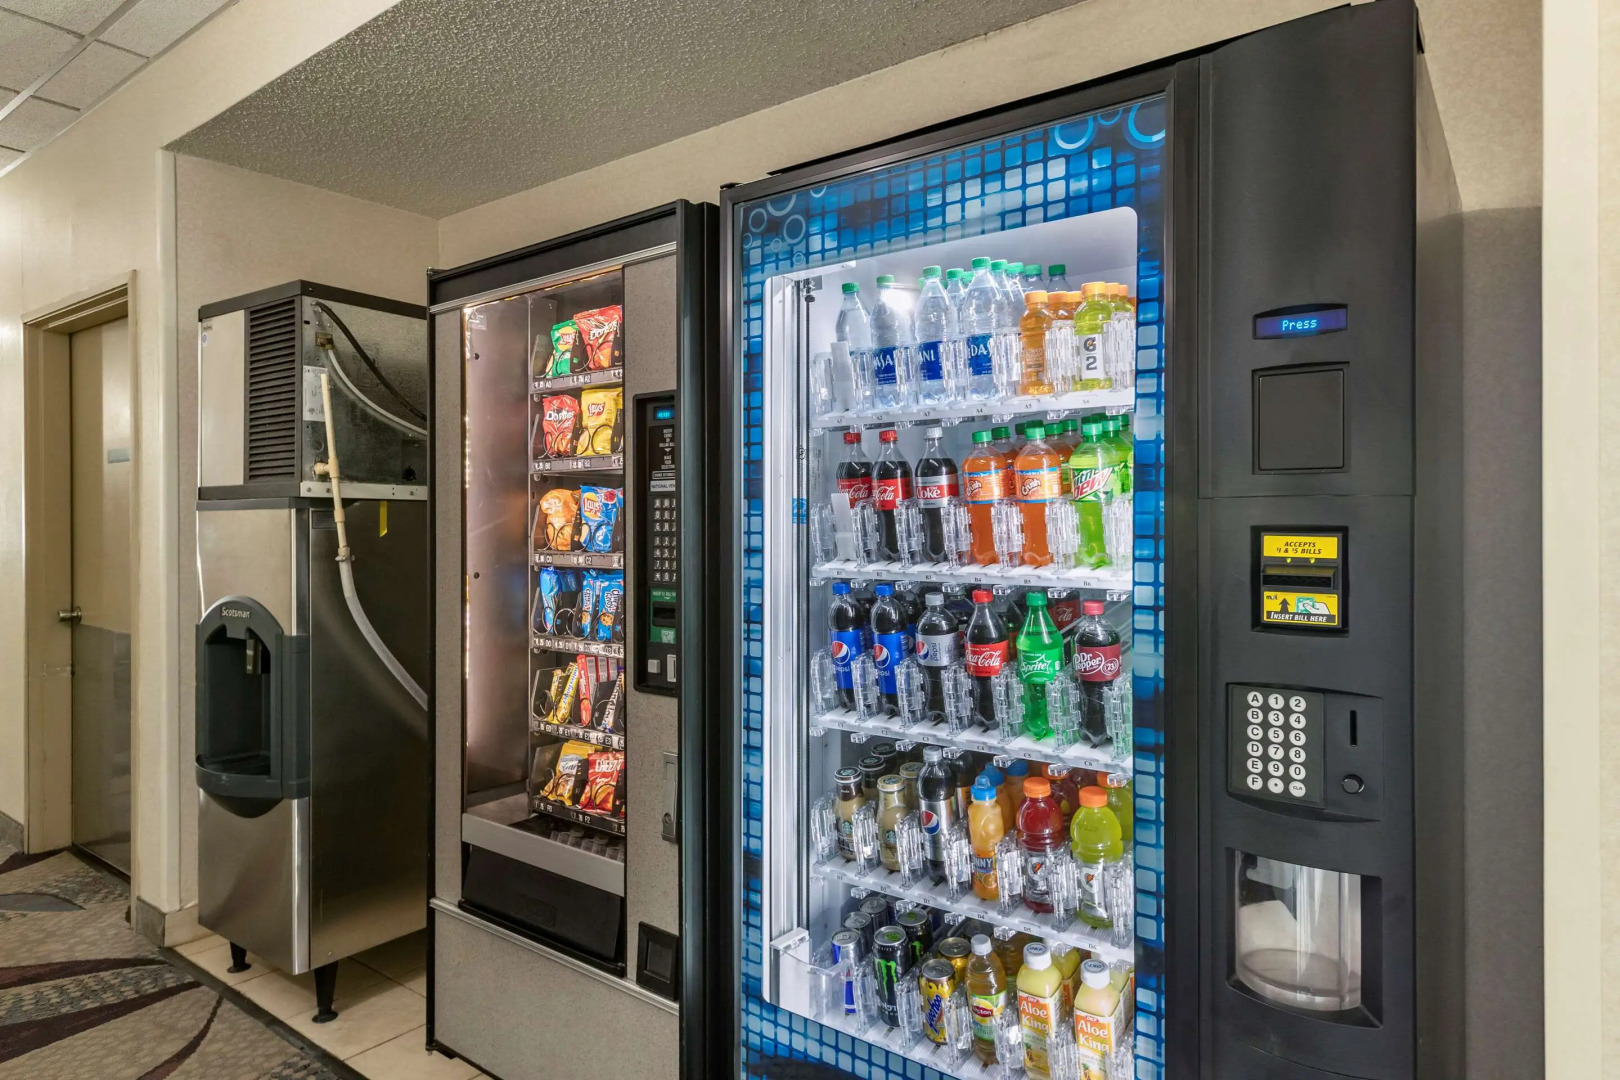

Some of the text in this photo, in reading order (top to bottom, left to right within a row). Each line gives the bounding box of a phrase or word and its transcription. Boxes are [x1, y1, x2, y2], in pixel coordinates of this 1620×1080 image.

[1282, 320, 1317, 330] Press
[1084, 337, 1096, 352] G
[1086, 356, 1097, 370] 2
[917, 486, 940, 499] Coke
[1022, 478, 1040, 496] Crush
[222, 607, 250, 618] Scotsman
[1271, 612, 1293, 620] INSERT
[966, 650, 1002, 666] Coca-Cola
[1073, 654, 1101, 672] Pepper
[1022, 661, 1046, 672] Sprite
[1251, 694, 1260, 703] A
[1294, 699, 1301, 707] 2
[1252, 711, 1301, 724] B 3 4
[1251, 727, 1301, 741] C 5 6
[1252, 744, 1300, 758] D 7 8
[1252, 761, 1301, 775] E 9 0
[1252, 777, 1258, 785] F
[1020, 1001, 1048, 1018] Aloe
[1022, 1014, 1049, 1034] King
[1078, 1020, 1108, 1038] Aloe
[1080, 1034, 1109, 1053] King
